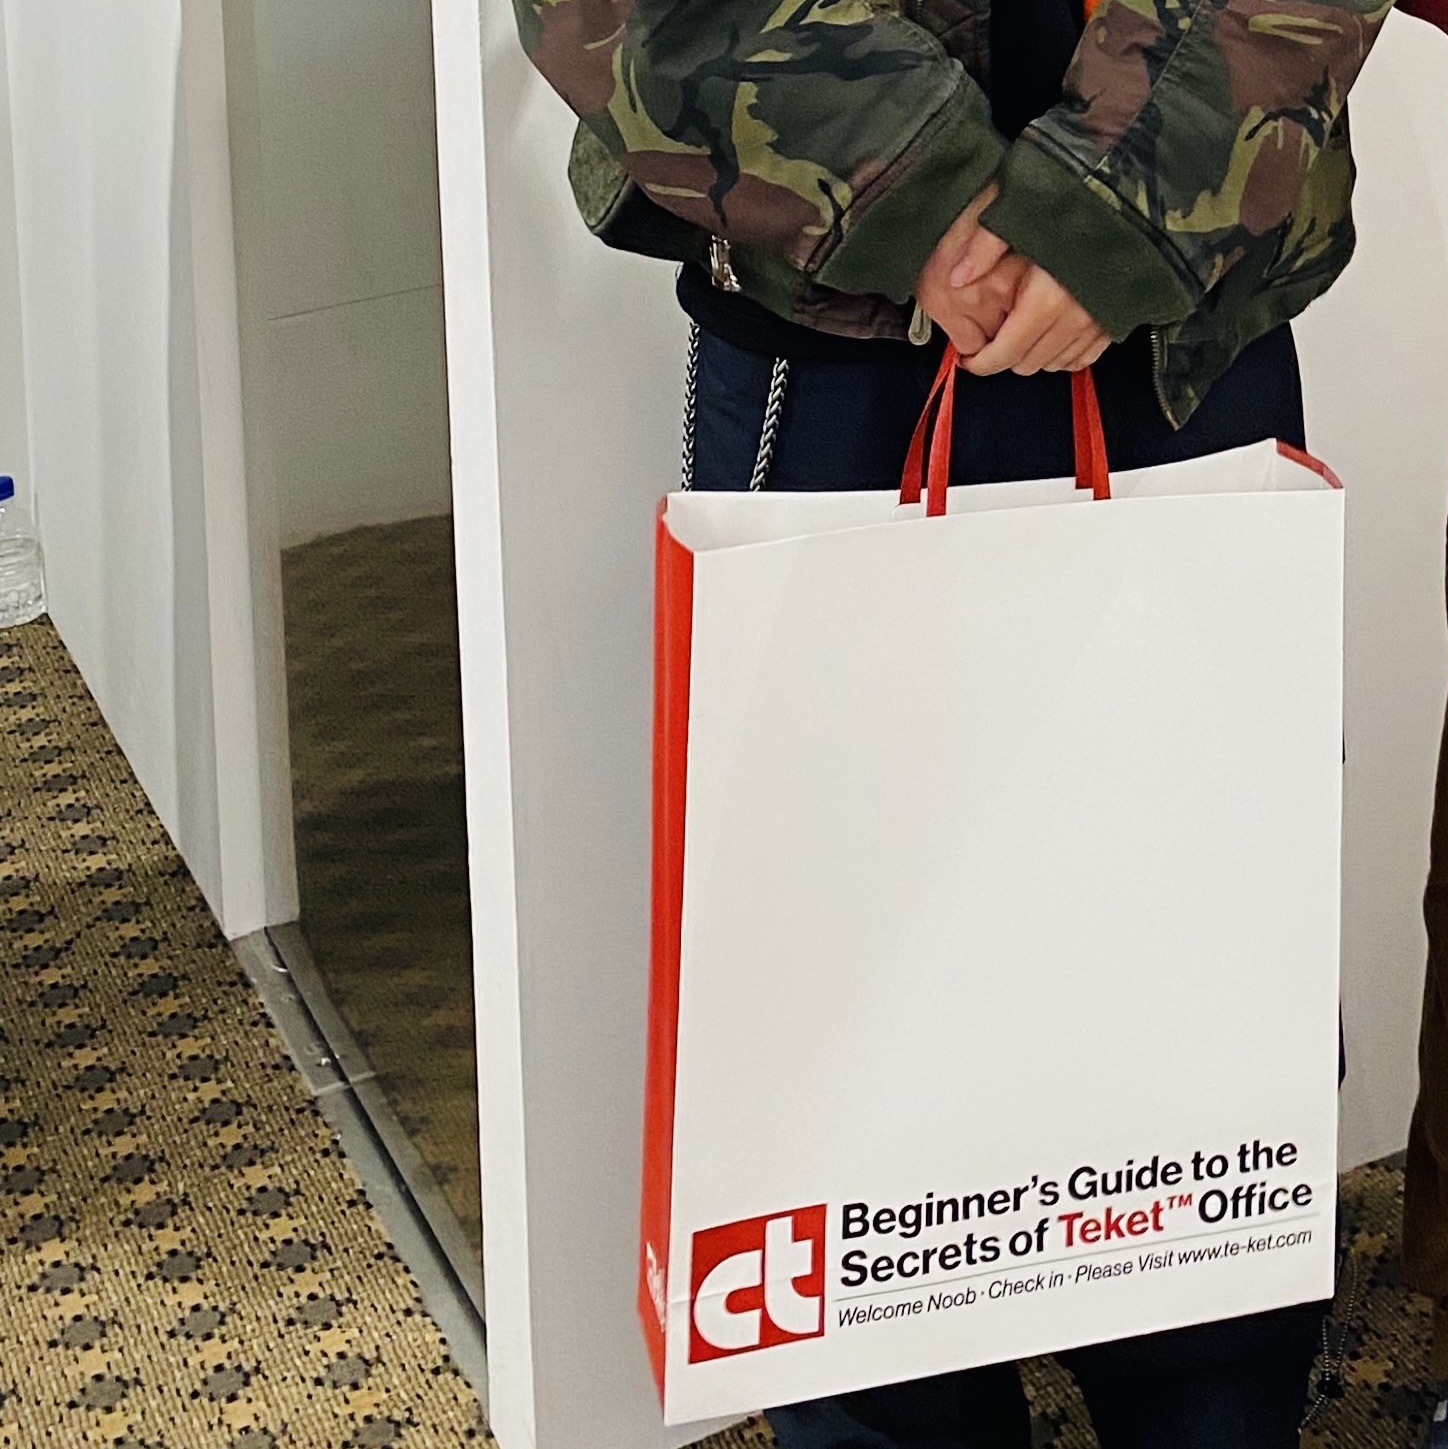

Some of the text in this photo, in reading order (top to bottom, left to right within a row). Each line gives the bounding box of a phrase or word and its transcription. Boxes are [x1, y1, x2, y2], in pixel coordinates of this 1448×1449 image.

[840, 1233, 1001, 1287] Secrets
[1009, 1217, 1049, 1256] of
[1198, 1180, 1312, 1224] Office
[841, 1140, 1297, 1240] Beginner's Guide to the
[838, 1229, 1312, 1328] Welcome Noob Check in Please Visit www.te-ket.com
